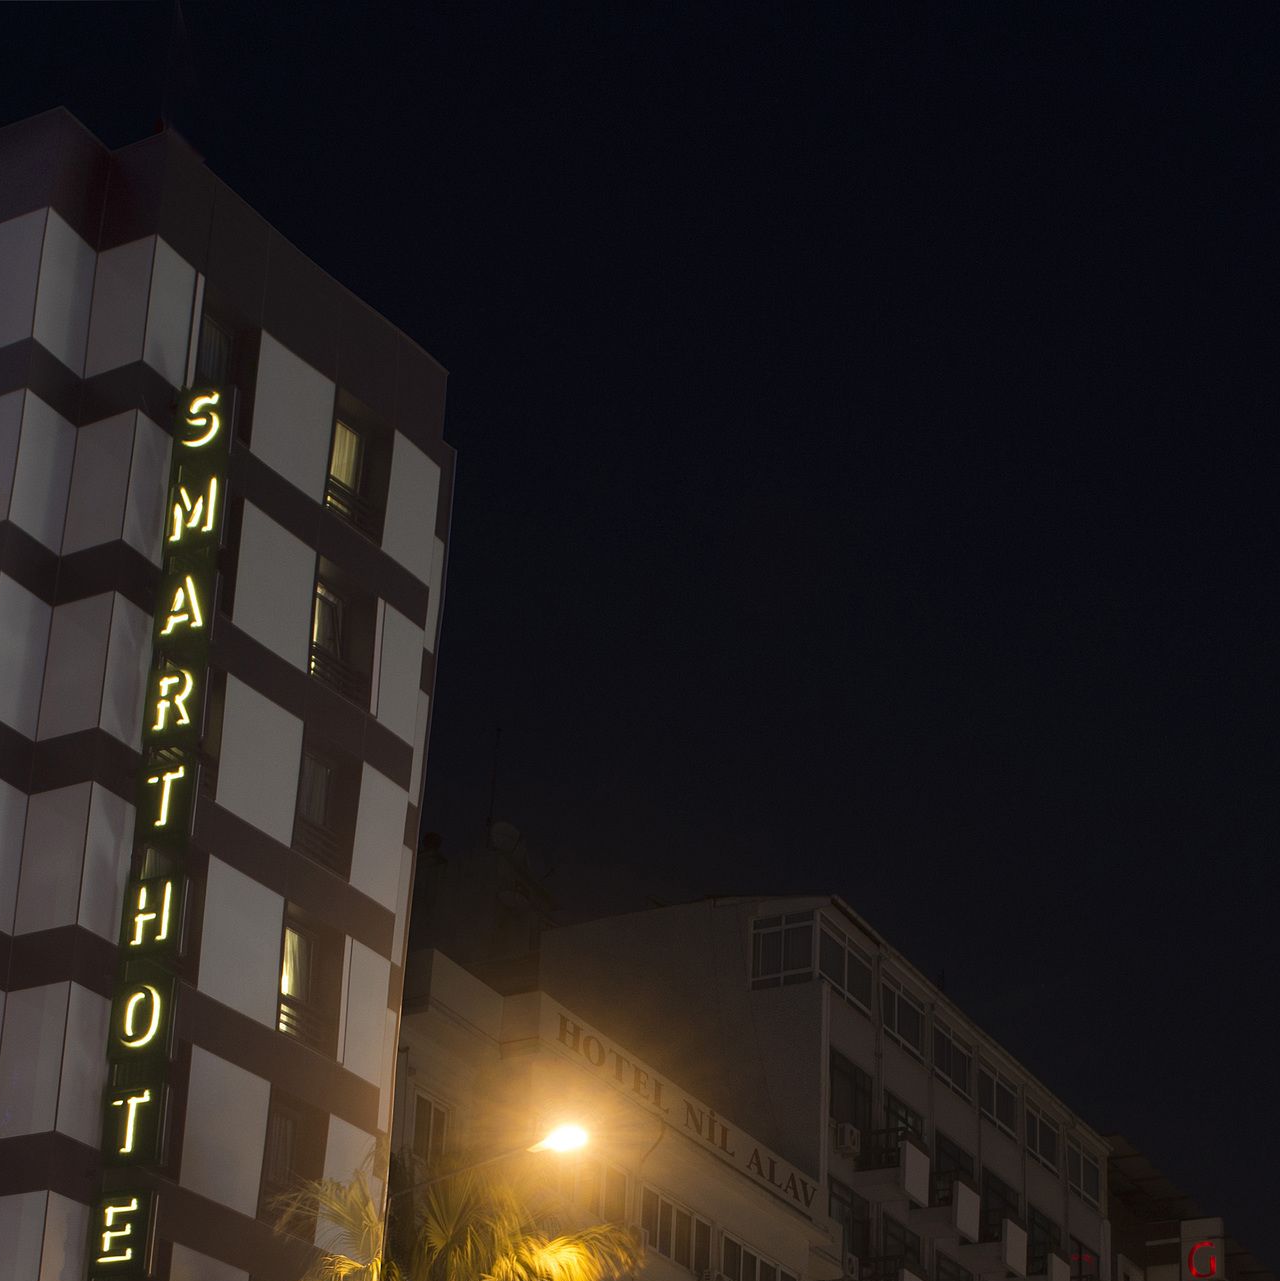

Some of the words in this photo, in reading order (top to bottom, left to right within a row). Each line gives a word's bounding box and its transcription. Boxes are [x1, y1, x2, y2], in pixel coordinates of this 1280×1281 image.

[145, 391, 220, 827] SMART
[558, 1012, 670, 1115] HOTEL
[683, 1098, 736, 1158] NİL
[746, 1147, 818, 1209] ALAV
